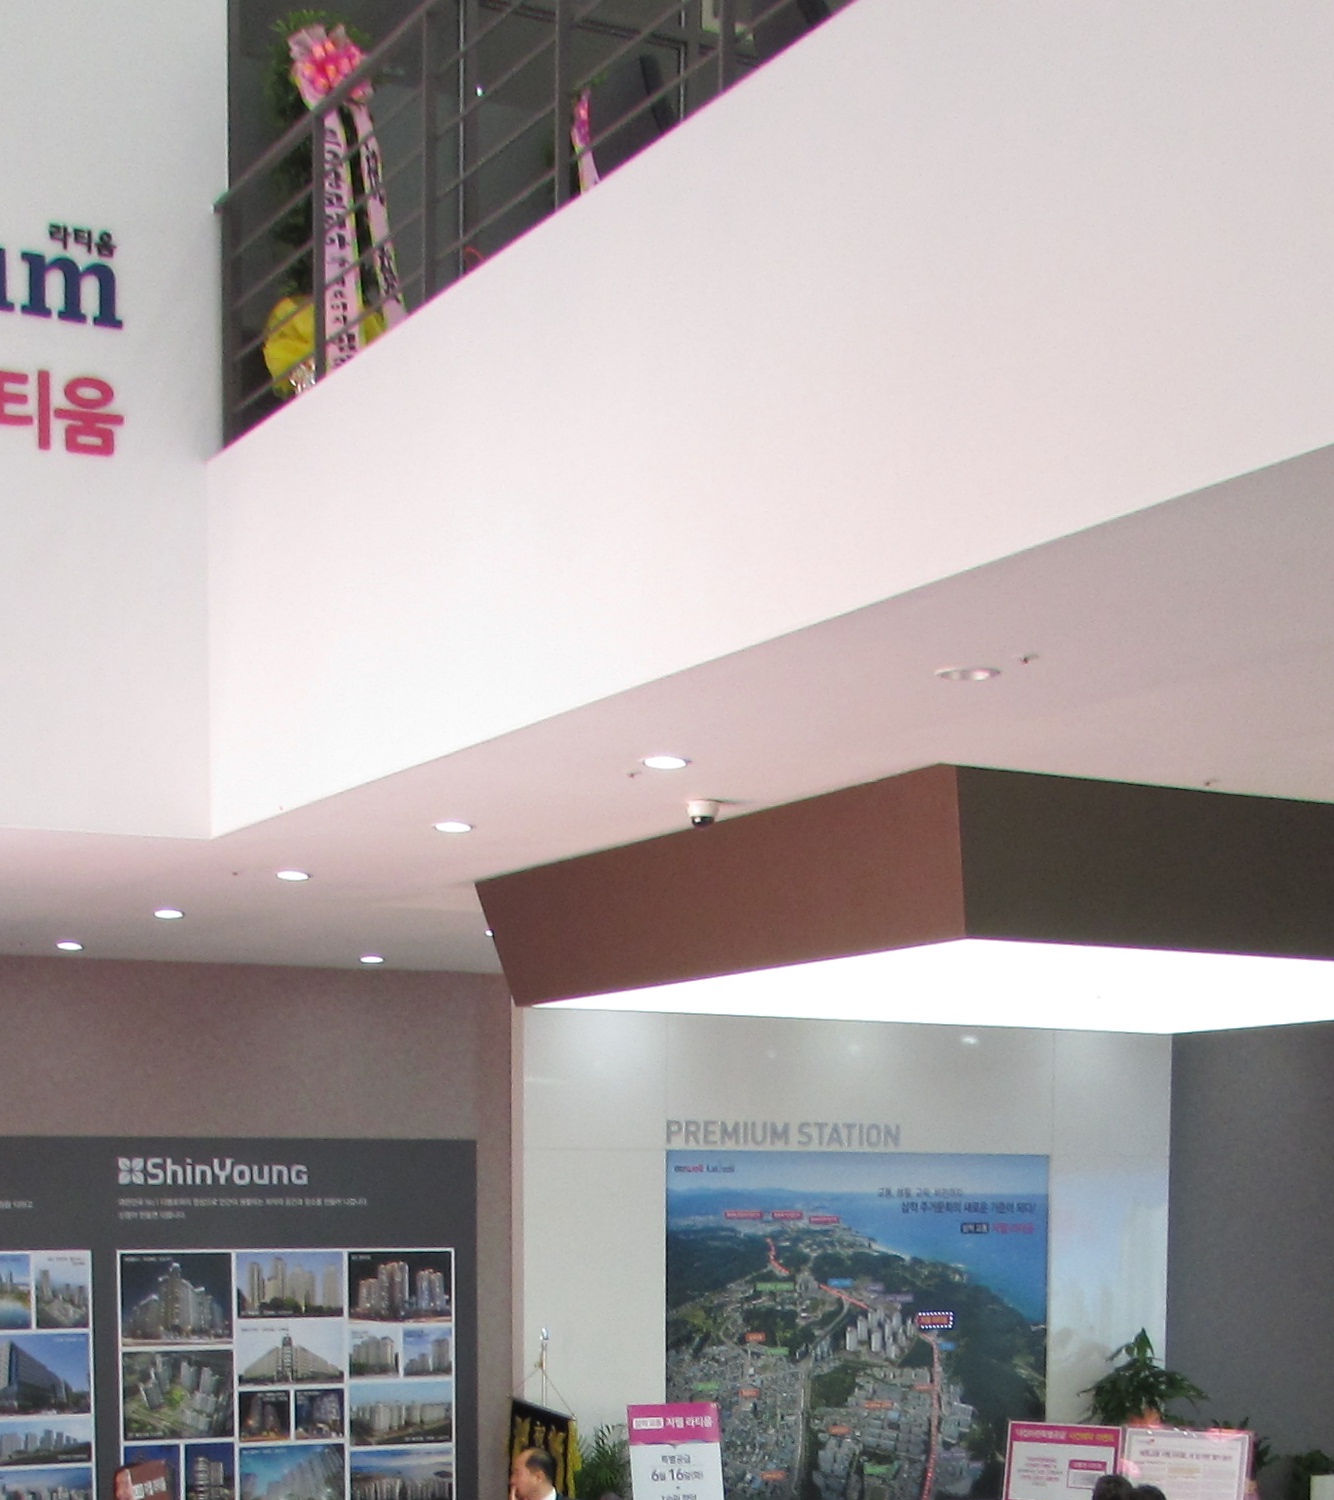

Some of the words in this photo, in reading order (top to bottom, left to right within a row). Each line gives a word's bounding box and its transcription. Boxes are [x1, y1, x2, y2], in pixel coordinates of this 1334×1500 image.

[47, 222, 117, 258] 라티움
[666, 1119, 791, 1147] PREMIUM
[797, 1122, 902, 1148] STATION
[146, 1157, 310, 1186] ShinYoung
